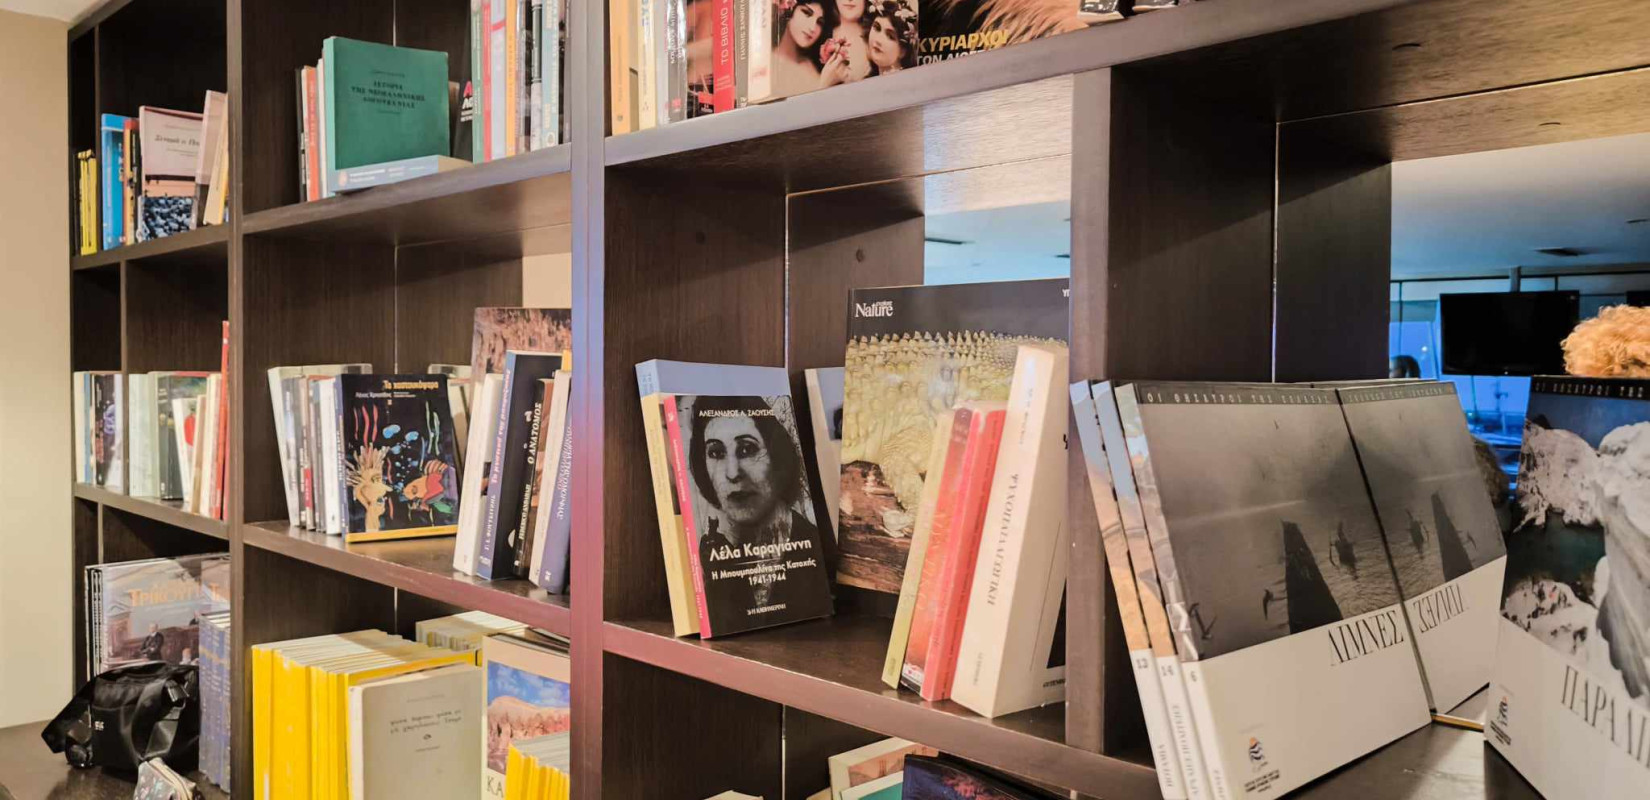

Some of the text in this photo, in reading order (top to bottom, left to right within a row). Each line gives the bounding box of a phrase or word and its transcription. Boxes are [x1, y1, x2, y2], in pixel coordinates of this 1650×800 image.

[721, 8, 729, 65] ΤΟ ΒΙΒΛΙΟ
[855, 302, 894, 317] Nature
[528, 402, 543, 465] Ο ΑΝΑΤΟΜΟΣ
[709, 538, 812, 562] Λέλα Καραγιάννη
[711, 571, 719, 580] Η
[720, 562, 773, 579] Μπουμπουλίνα
[786, 557, 817, 569] Κατοχής
[748, 571, 787, 586] 1941-1944
[1328, 609, 1404, 666] ΛΙΜΝΕΣ
[1136, 658, 1149, 669] 13
